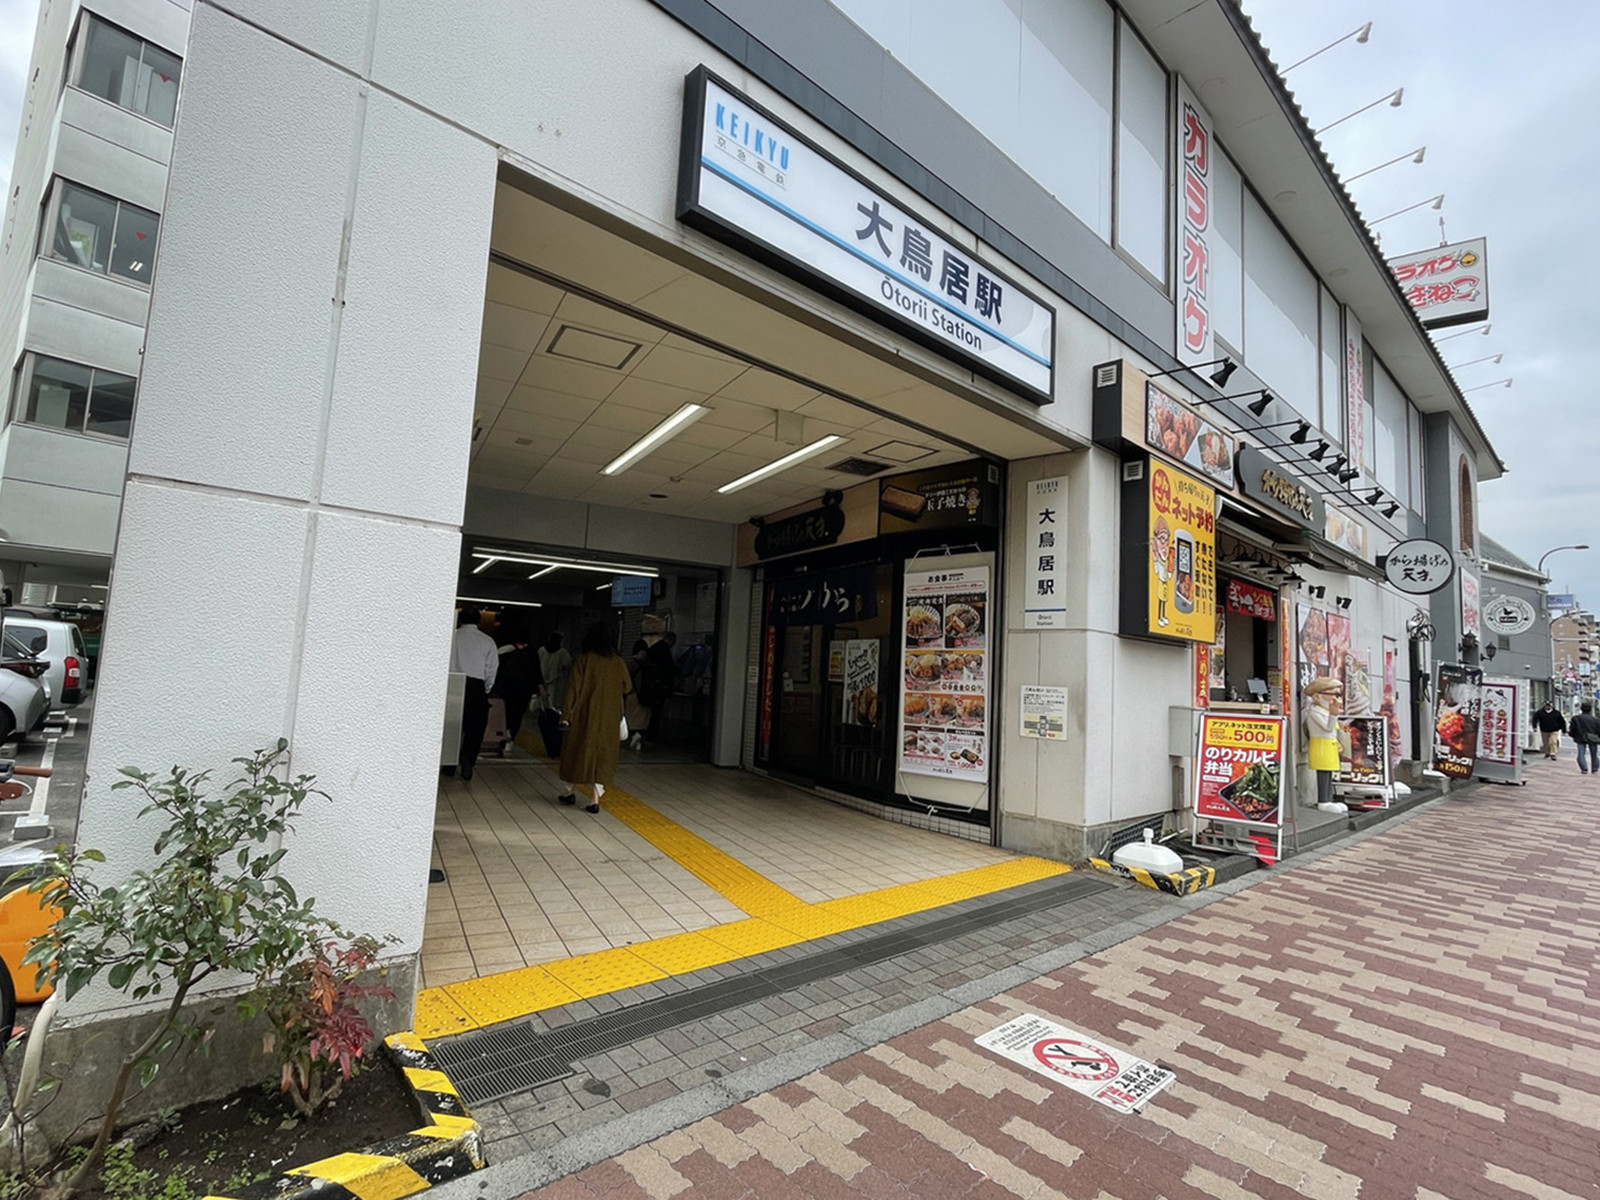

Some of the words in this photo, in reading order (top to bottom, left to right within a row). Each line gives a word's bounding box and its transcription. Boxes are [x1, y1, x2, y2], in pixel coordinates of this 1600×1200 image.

[715, 102, 790, 171] KEIKYU
[716, 135, 786, 187] 京急電鉄
[1184, 104, 1208, 351] カラオケ
[855, 200, 1003, 325] 大鳥居駅
[1391, 256, 1457, 282] ラオケ
[931, 308, 983, 352] Station
[1172, 497, 1213, 533] ネット予約
[1037, 508, 1055, 595] 大鳥居駅
[1389, 554, 1449, 567] から揚げの
[1234, 730, 1275, 744] 500円
[1204, 760, 1233, 776] 弁当
[1205, 747, 1277, 768] のりカルビ
[1097, 1086, 1137, 1108] 禁止
